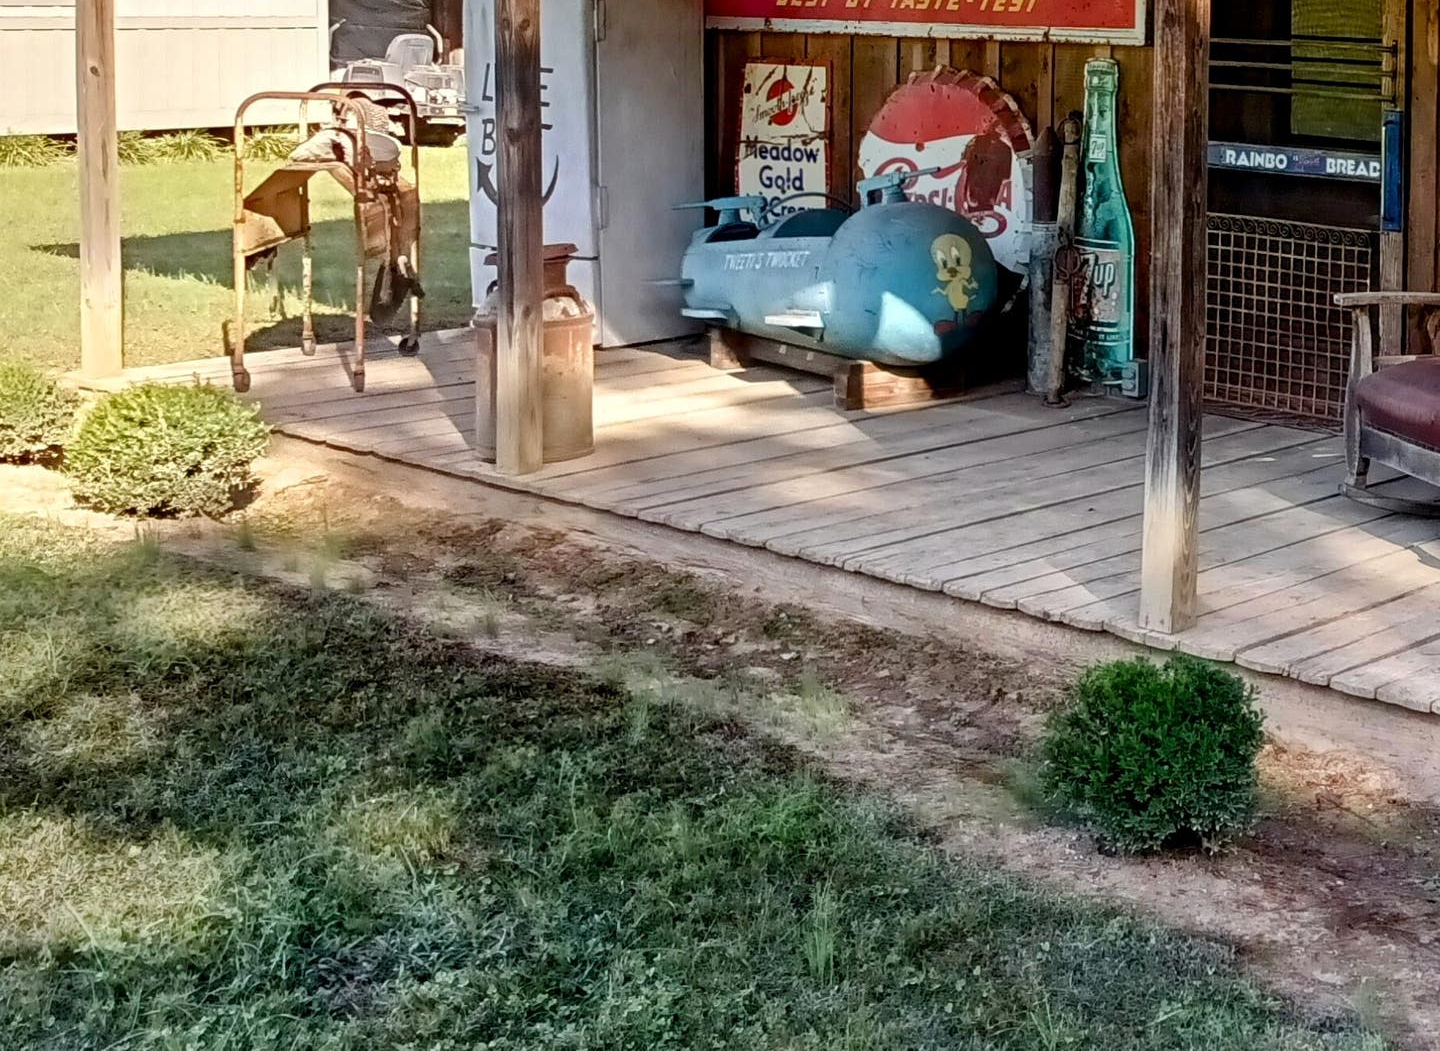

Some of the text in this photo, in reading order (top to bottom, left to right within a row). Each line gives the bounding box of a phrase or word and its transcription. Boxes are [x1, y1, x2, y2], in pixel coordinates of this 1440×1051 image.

[745, 135, 820, 164] Meadow
[1225, 149, 1288, 170] RAINBO
[1326, 157, 1381, 178] BREAD
[759, 165, 805, 191] Gold
